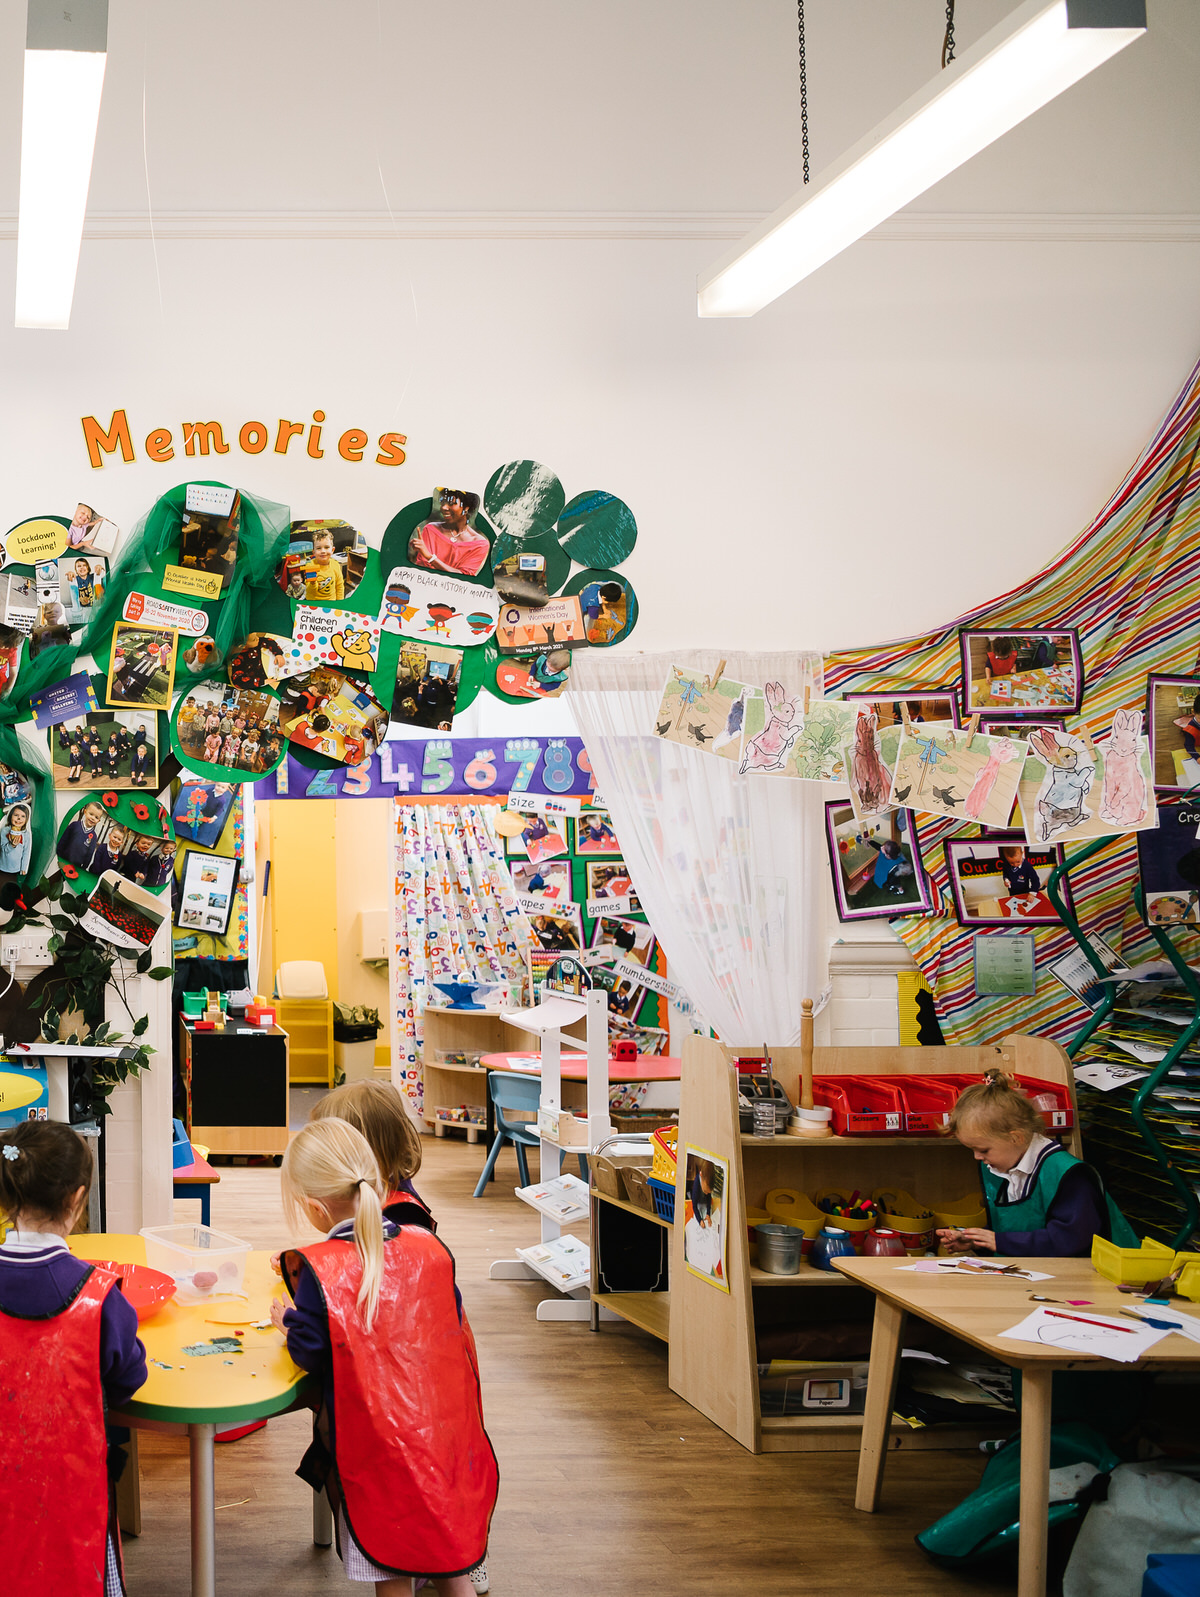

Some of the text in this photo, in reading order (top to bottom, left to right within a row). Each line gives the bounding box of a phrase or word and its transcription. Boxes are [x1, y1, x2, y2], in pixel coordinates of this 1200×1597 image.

[81, 409, 407, 468] Memories
[17, 531, 56, 544] Lockdown
[21, 541, 57, 555] Learning!
[395, 570, 493, 599] HAPPY BLACK HISTORY MONTH
[528, 604, 566, 614] International
[157, 610, 178, 622] November
[300, 615, 338, 626] Children
[528, 612, 556, 621] Women's
[309, 624, 333, 633] Need
[341, 756, 372, 795] 3
[377, 742, 414, 792] 4
[421, 740, 454, 793] 5
[464, 749, 497, 790] 6
[504, 740, 542, 792] 7
[542, 739, 574, 793] 8
[510, 797, 534, 808] size
[962, 862, 988, 874] Our
[518, 898, 545, 910] apes
[589, 902, 621, 916] games
[619, 963, 662, 988] numbers
